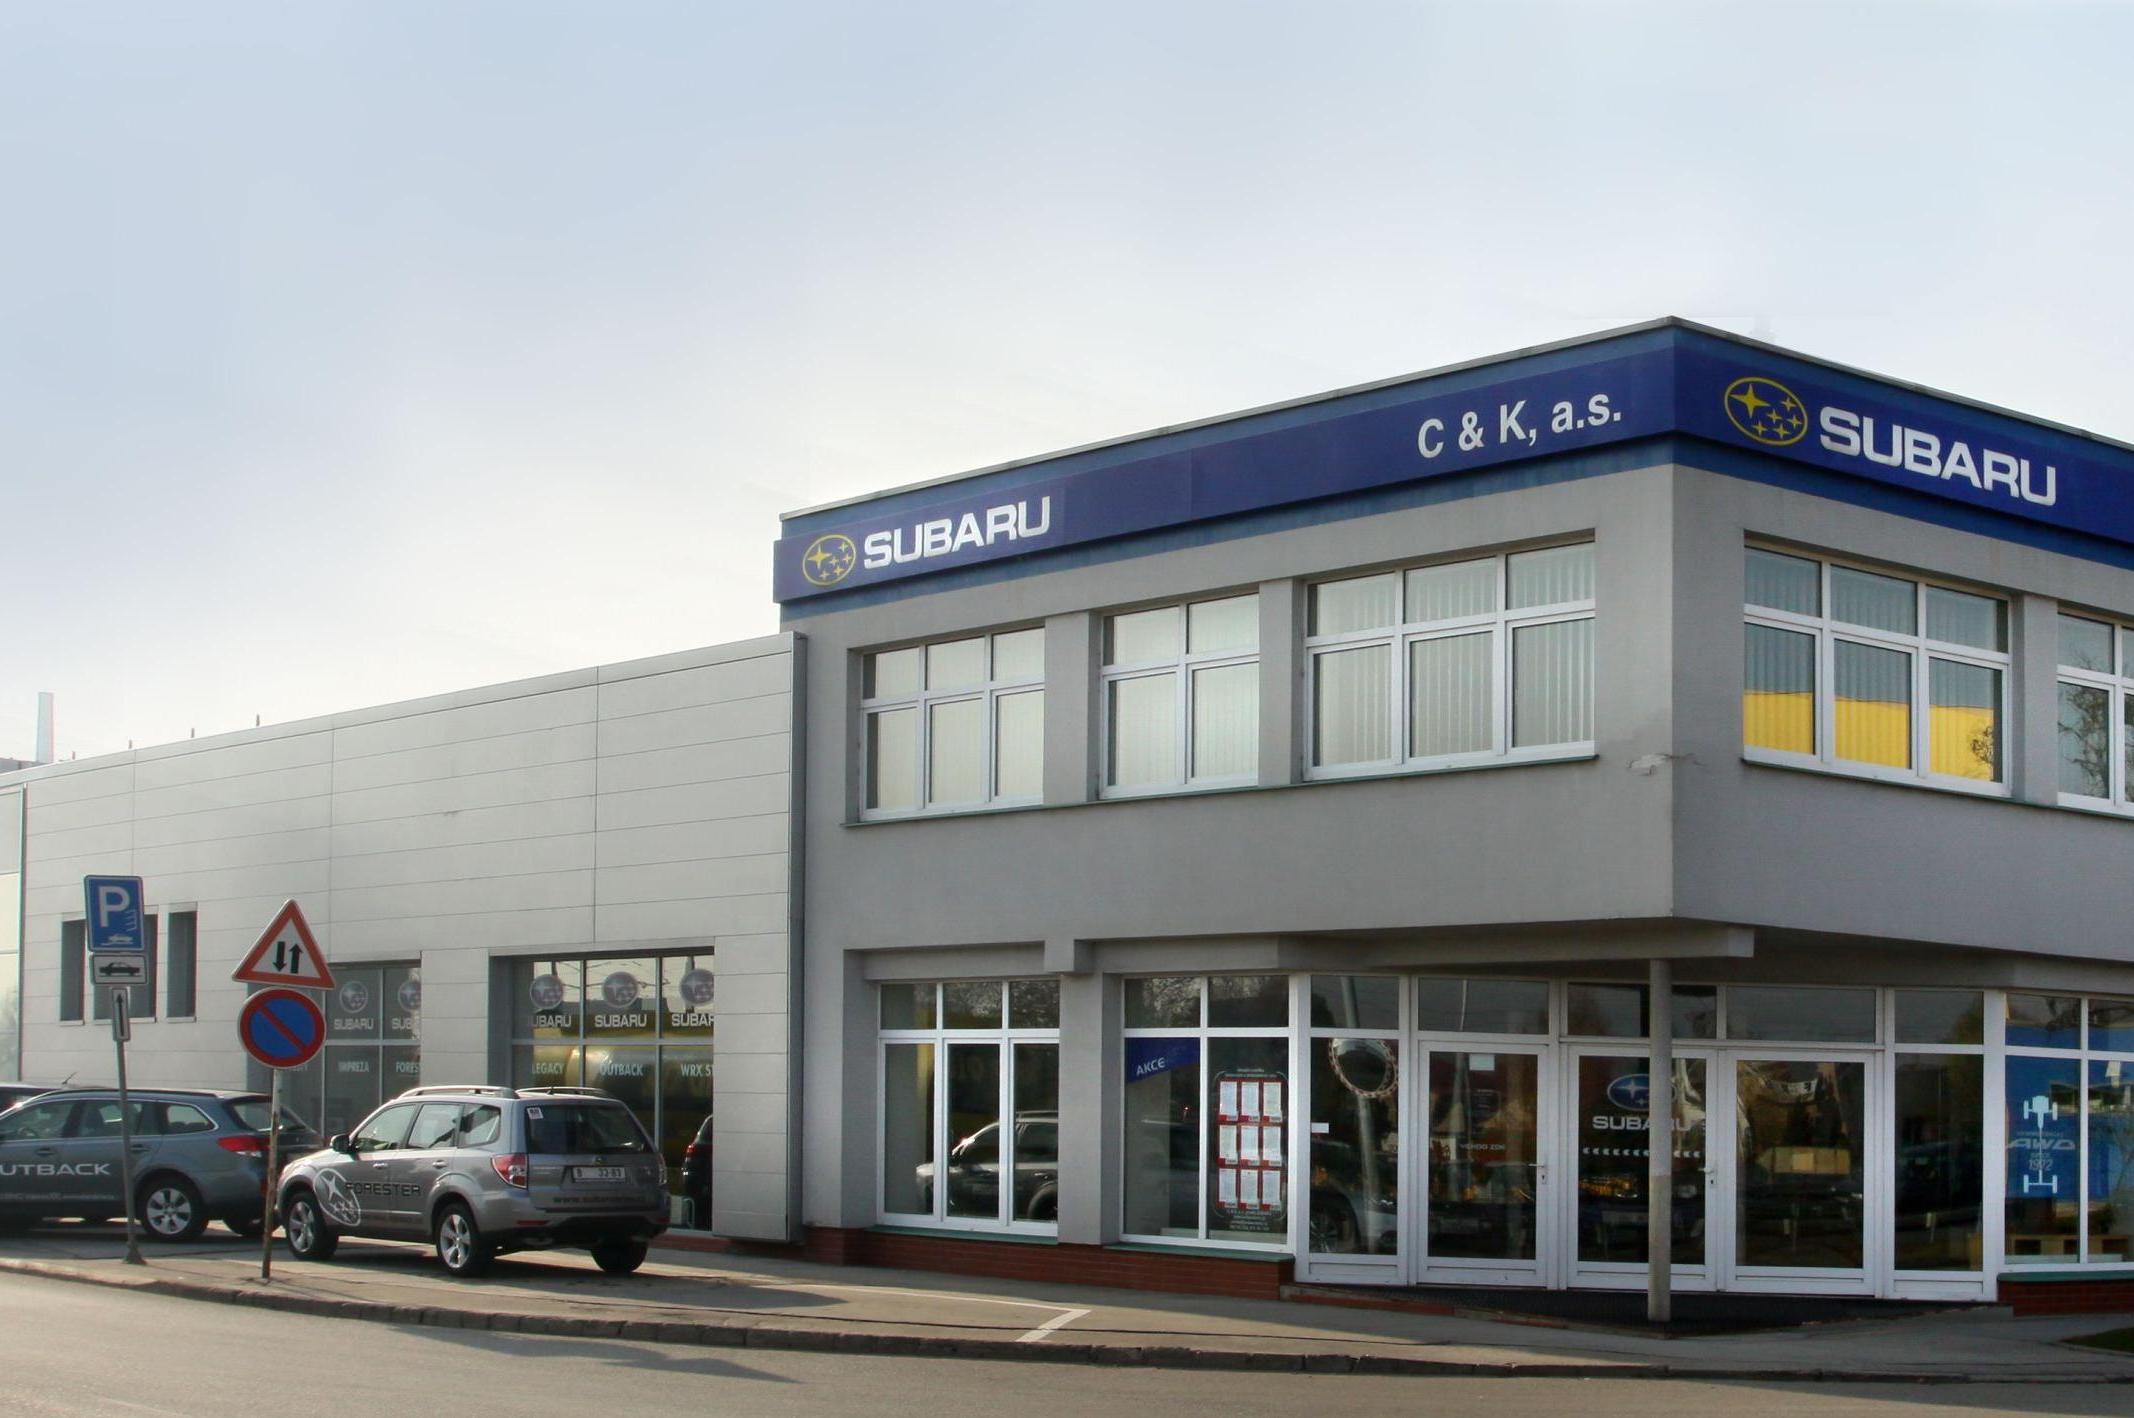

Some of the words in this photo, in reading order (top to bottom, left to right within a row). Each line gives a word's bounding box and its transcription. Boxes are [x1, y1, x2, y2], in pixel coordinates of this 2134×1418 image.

[1418, 418, 1444, 458] C
[1458, 411, 1484, 451] &
[1499, 400, 1537, 447] K,
[1551, 393, 1621, 433] a.s.
[1819, 406, 2056, 506] SUBARU
[863, 495, 1051, 570] SUBARU
[98, 886, 130, 927] P
[334, 1018, 374, 1030] SUBARU
[594, 1014, 647, 1027] SUBARU
[338, 1061, 370, 1073] IMPREZA
[531, 1062, 565, 1075] LEGACY
[599, 1063, 644, 1077] OUTBACK
[680, 1063, 704, 1077] WRX
[2006, 1137, 2076, 1150] AWD
[345, 1182, 421, 1197] FORESTER
